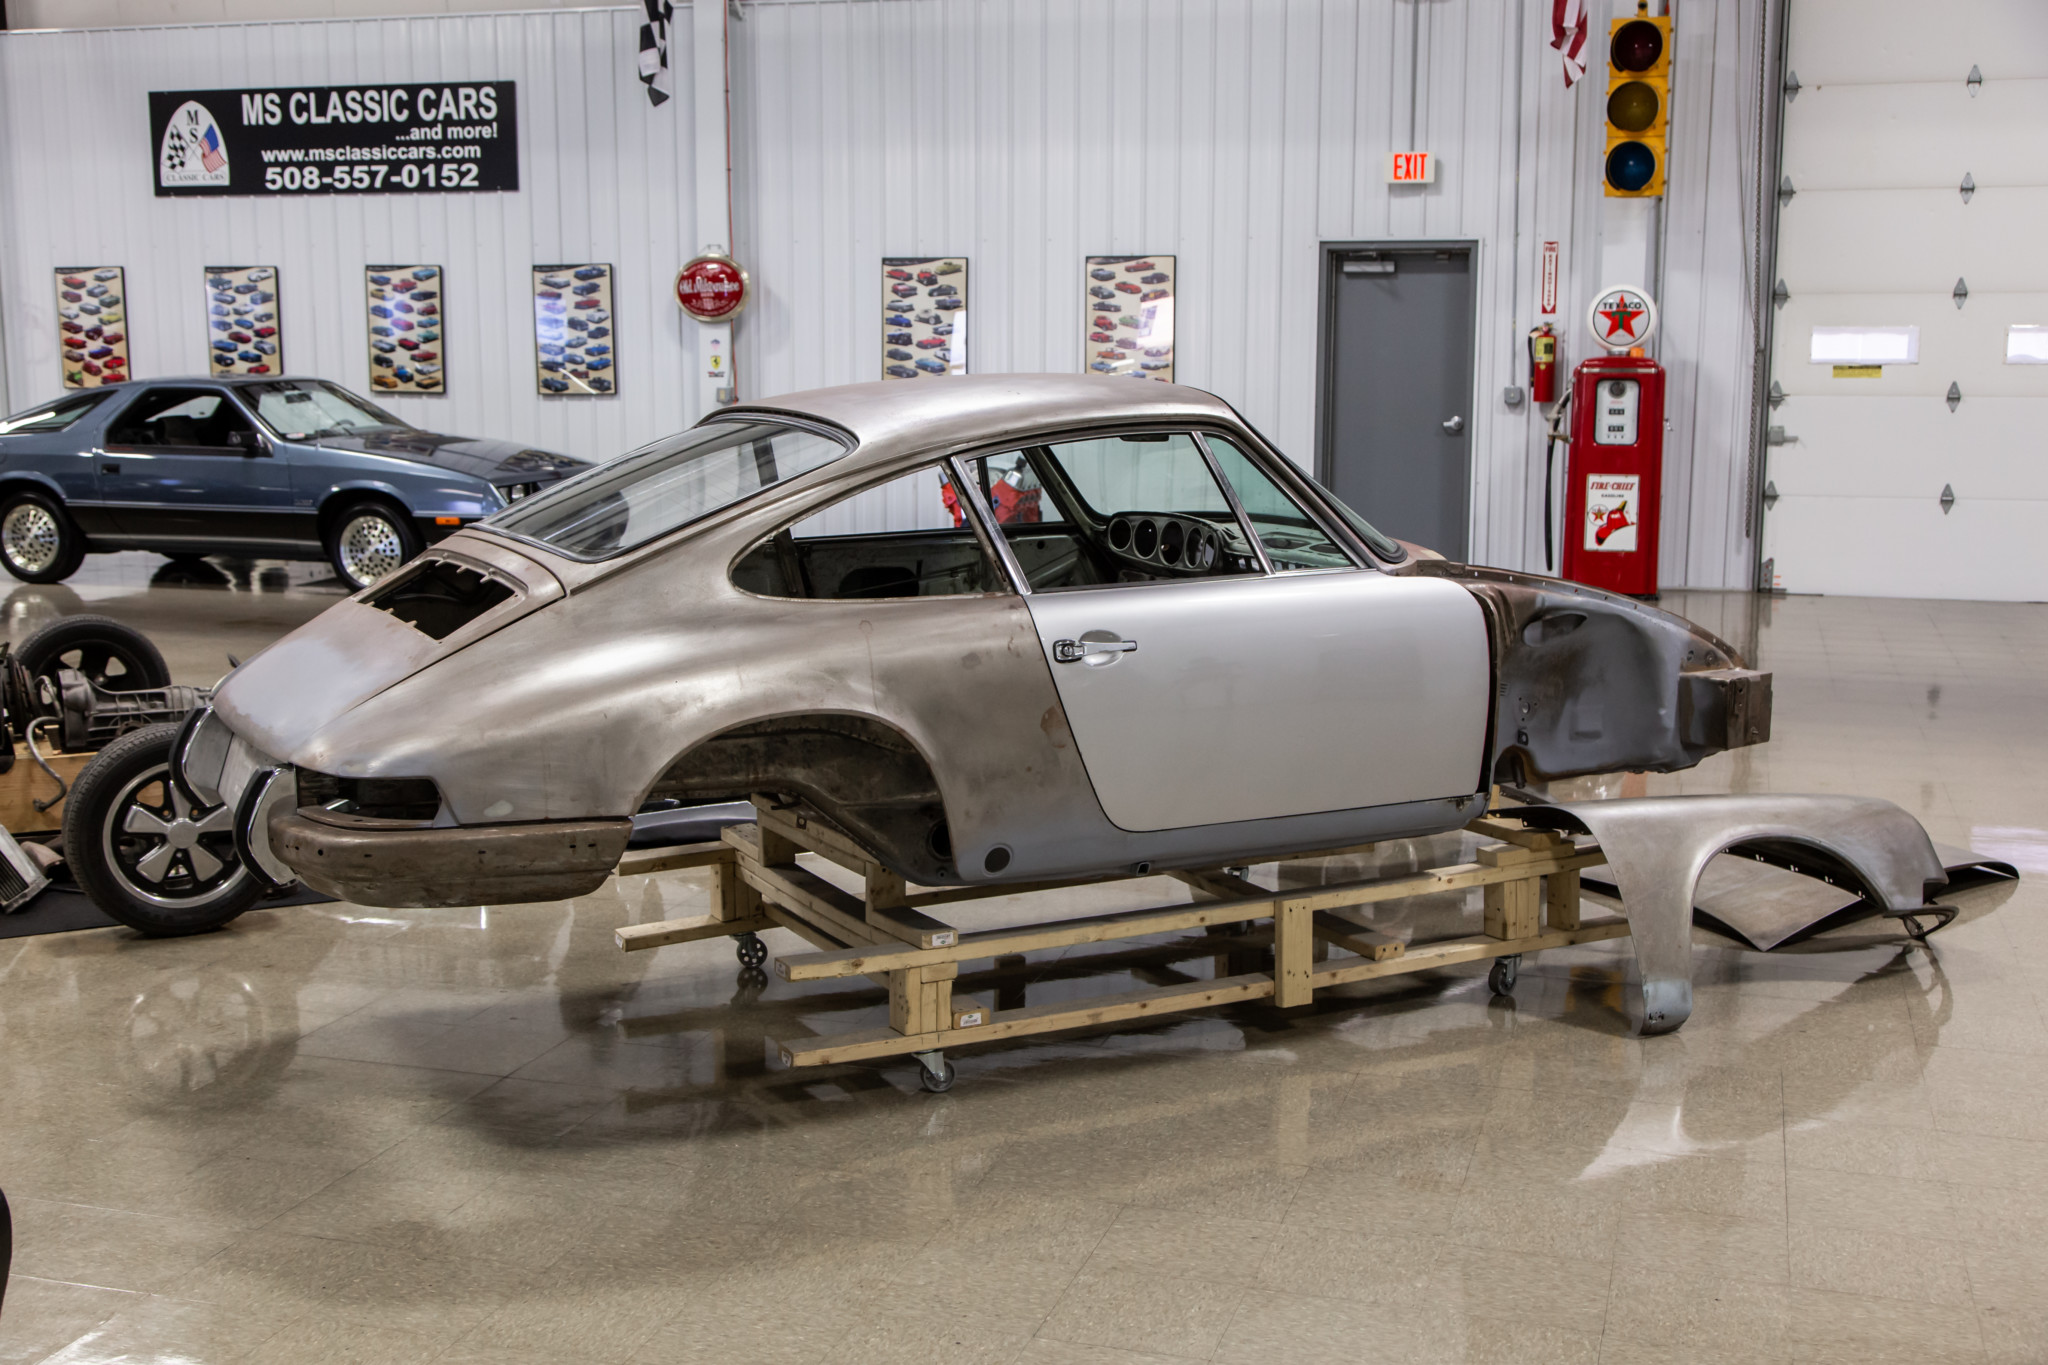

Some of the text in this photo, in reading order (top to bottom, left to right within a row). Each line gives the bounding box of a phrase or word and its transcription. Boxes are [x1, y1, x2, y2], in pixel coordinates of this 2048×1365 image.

[241, 86, 498, 126] MS CLASSIC CARS
[186, 109, 200, 126] M
[189, 128, 199, 144] S
[446, 121, 498, 140] more!
[261, 144, 482, 163] www.msclassiccars.com
[264, 162, 480, 191] 508-557-0152
[1393, 153, 1428, 181] EXIT
[1603, 301, 1642, 310] TEXACO
